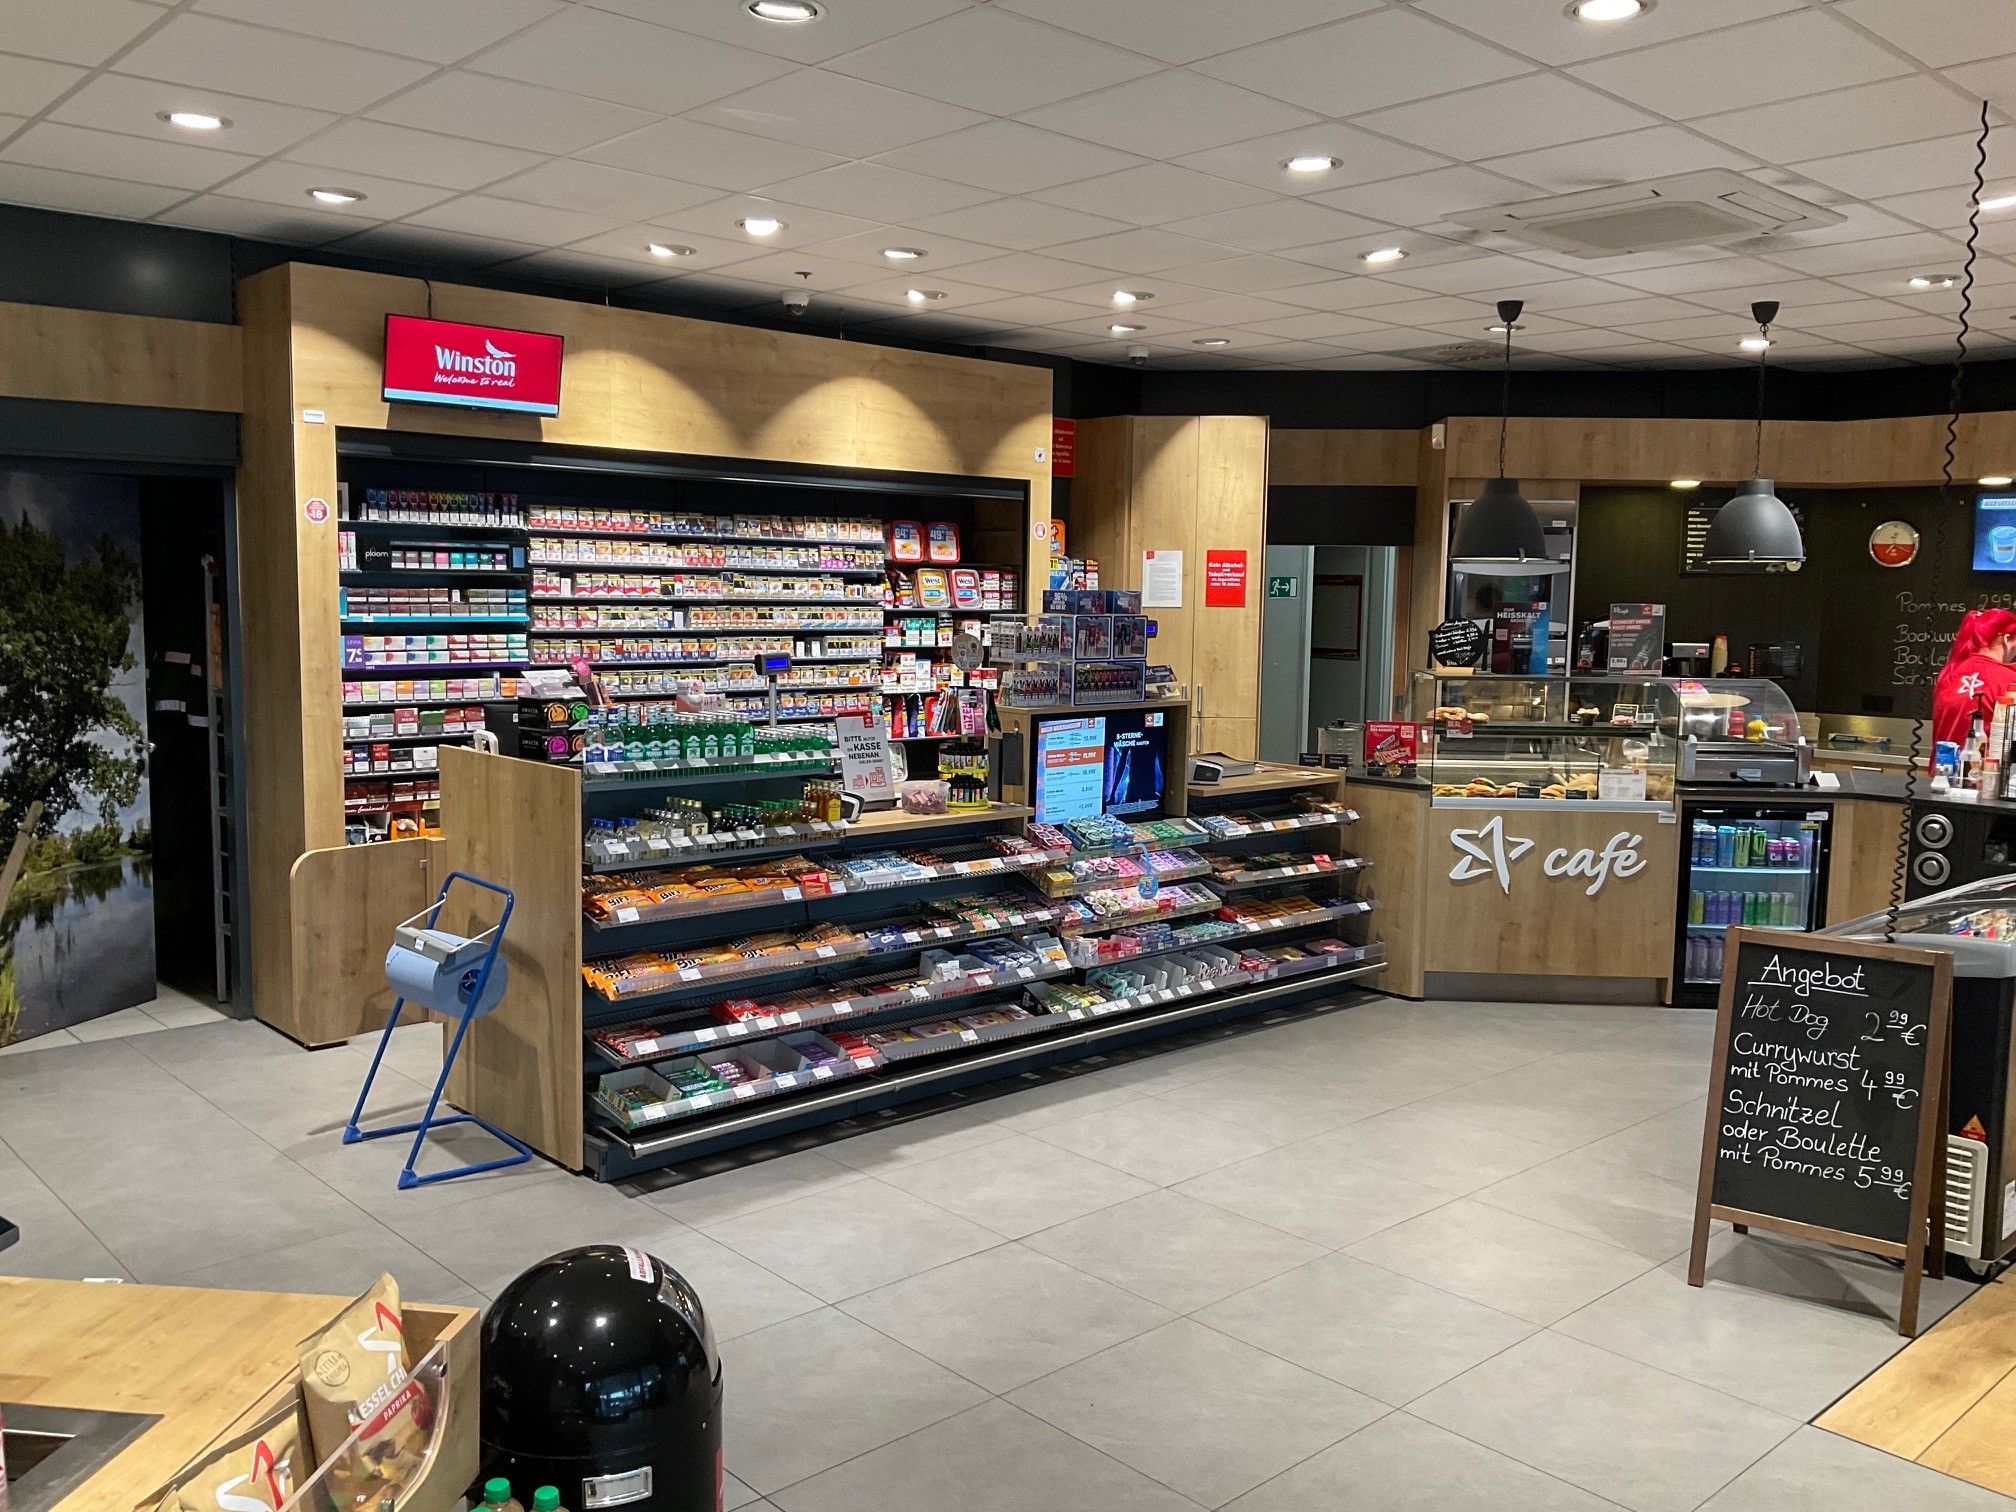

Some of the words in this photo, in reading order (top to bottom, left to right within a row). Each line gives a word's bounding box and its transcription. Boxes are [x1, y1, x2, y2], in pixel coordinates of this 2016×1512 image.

[435, 344, 516, 377] Winston
[434, 371, 478, 385] Welcome
[480, 377, 489, 386] to
[490, 377, 515, 388] real
[310, 509, 323, 519] 18
[924, 576, 941, 584] West
[958, 576, 974, 584] West
[963, 702, 973, 730] GIZEH
[854, 742, 882, 752] KASSE
[1113, 739, 1136, 747] WÄSCHE
[1116, 732, 1144, 740] 5-STERNE-
[849, 752, 879, 760] NEBENAN.
[1544, 831, 1647, 896] café
[1761, 954, 1866, 996] Angebot
[1741, 994, 1783, 1021] Hot
[1789, 1004, 1829, 1039] Dog
[1734, 1032, 1860, 1071] Currywurst
[1731, 1062, 1760, 1078] mit
[1765, 1063, 1849, 1092] Pommes
[1724, 1090, 1842, 1128] Schnitzel
[1723, 1120, 1768, 1141] oder
[1776, 1126, 1882, 1163] Boulette
[1721, 1145, 1751, 1163] mit
[1758, 1145, 1845, 1180] Pommes
[383, 1390, 412, 1420] PAPRIKA
